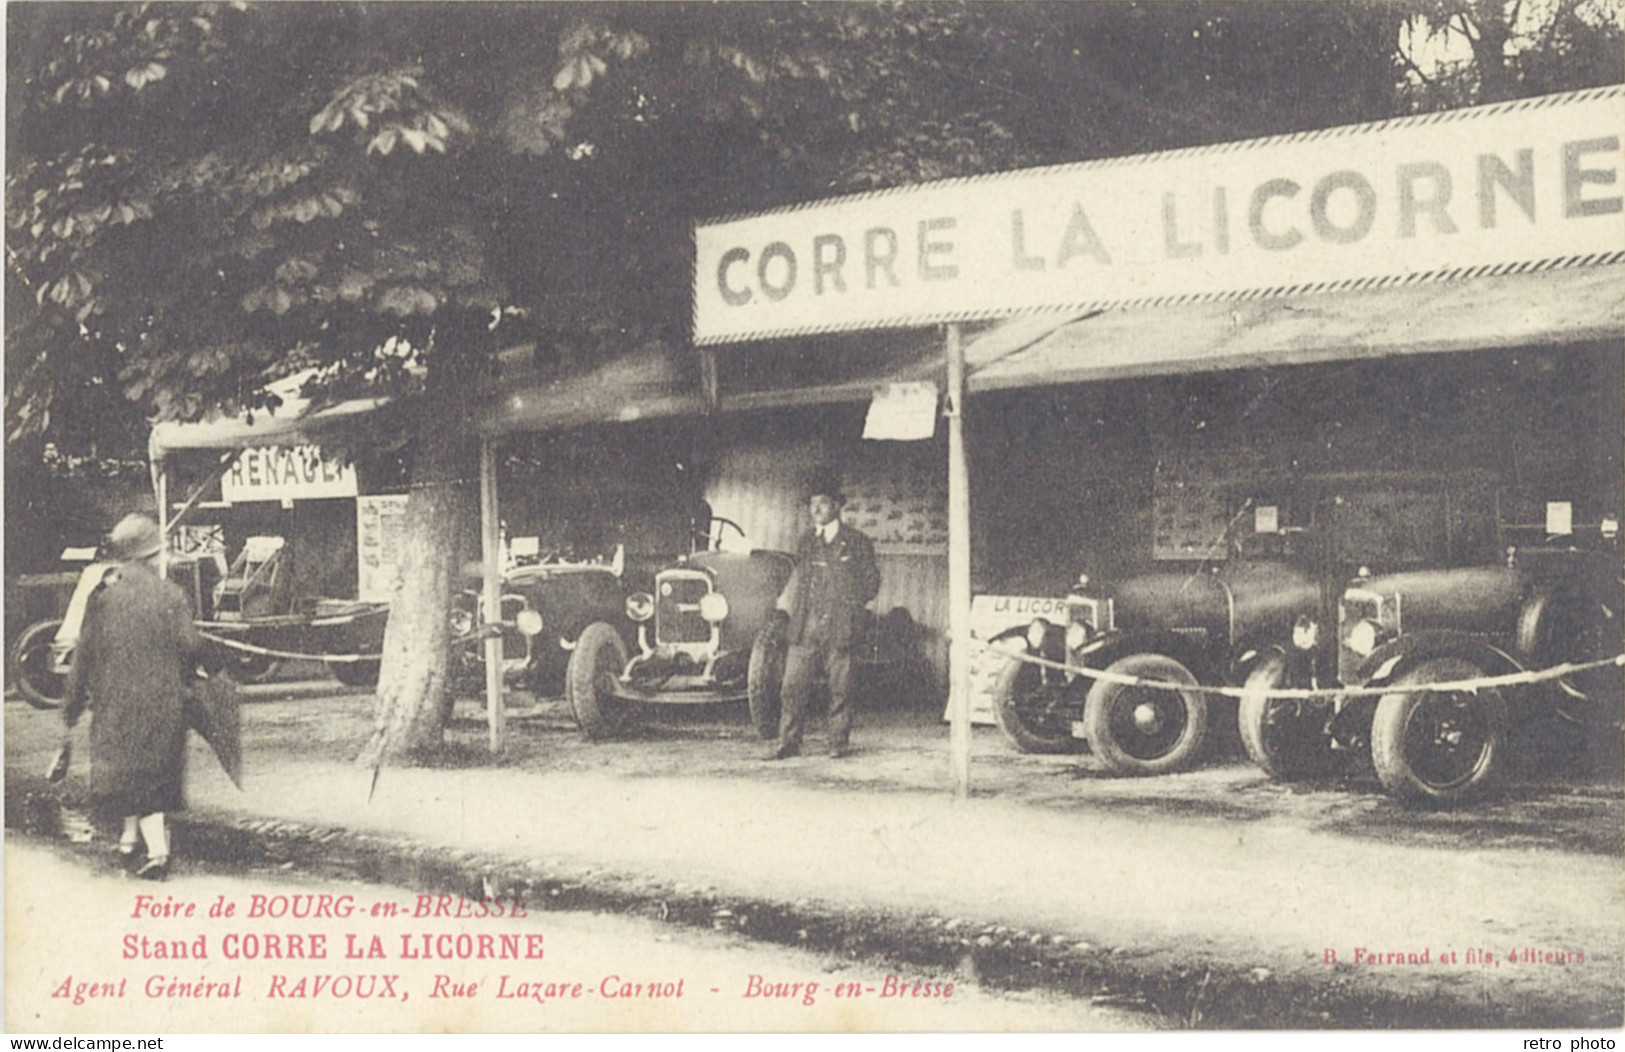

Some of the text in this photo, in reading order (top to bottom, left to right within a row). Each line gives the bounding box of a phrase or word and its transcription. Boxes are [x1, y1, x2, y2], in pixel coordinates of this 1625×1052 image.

[717, 134, 1624, 305] CORRE LA LICORNE
[994, 600, 1067, 614] LA LICOR
